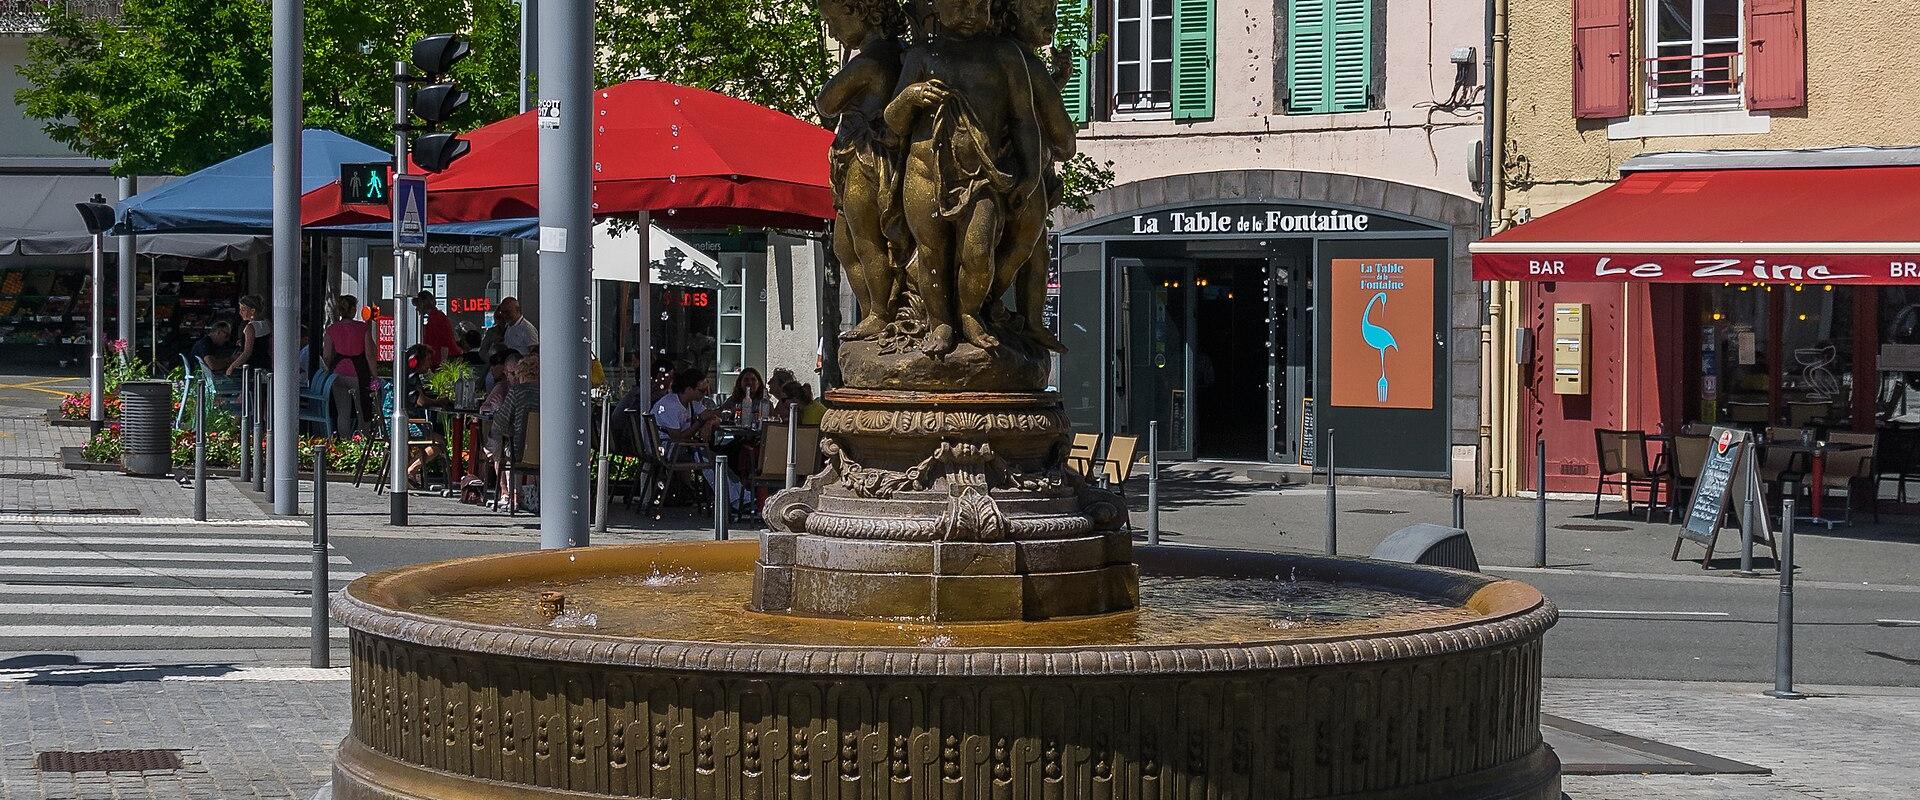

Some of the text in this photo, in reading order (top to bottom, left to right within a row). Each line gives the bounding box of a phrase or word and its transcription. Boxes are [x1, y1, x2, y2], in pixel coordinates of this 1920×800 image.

[1132, 210, 1369, 234] La Table de la Fontaine
[1360, 263, 1405, 273] La Table
[1529, 257, 1920, 280] BAR Le Zinc BR
[1360, 280, 1405, 290] Fontaine
[450, 298, 491, 313] SLDES
